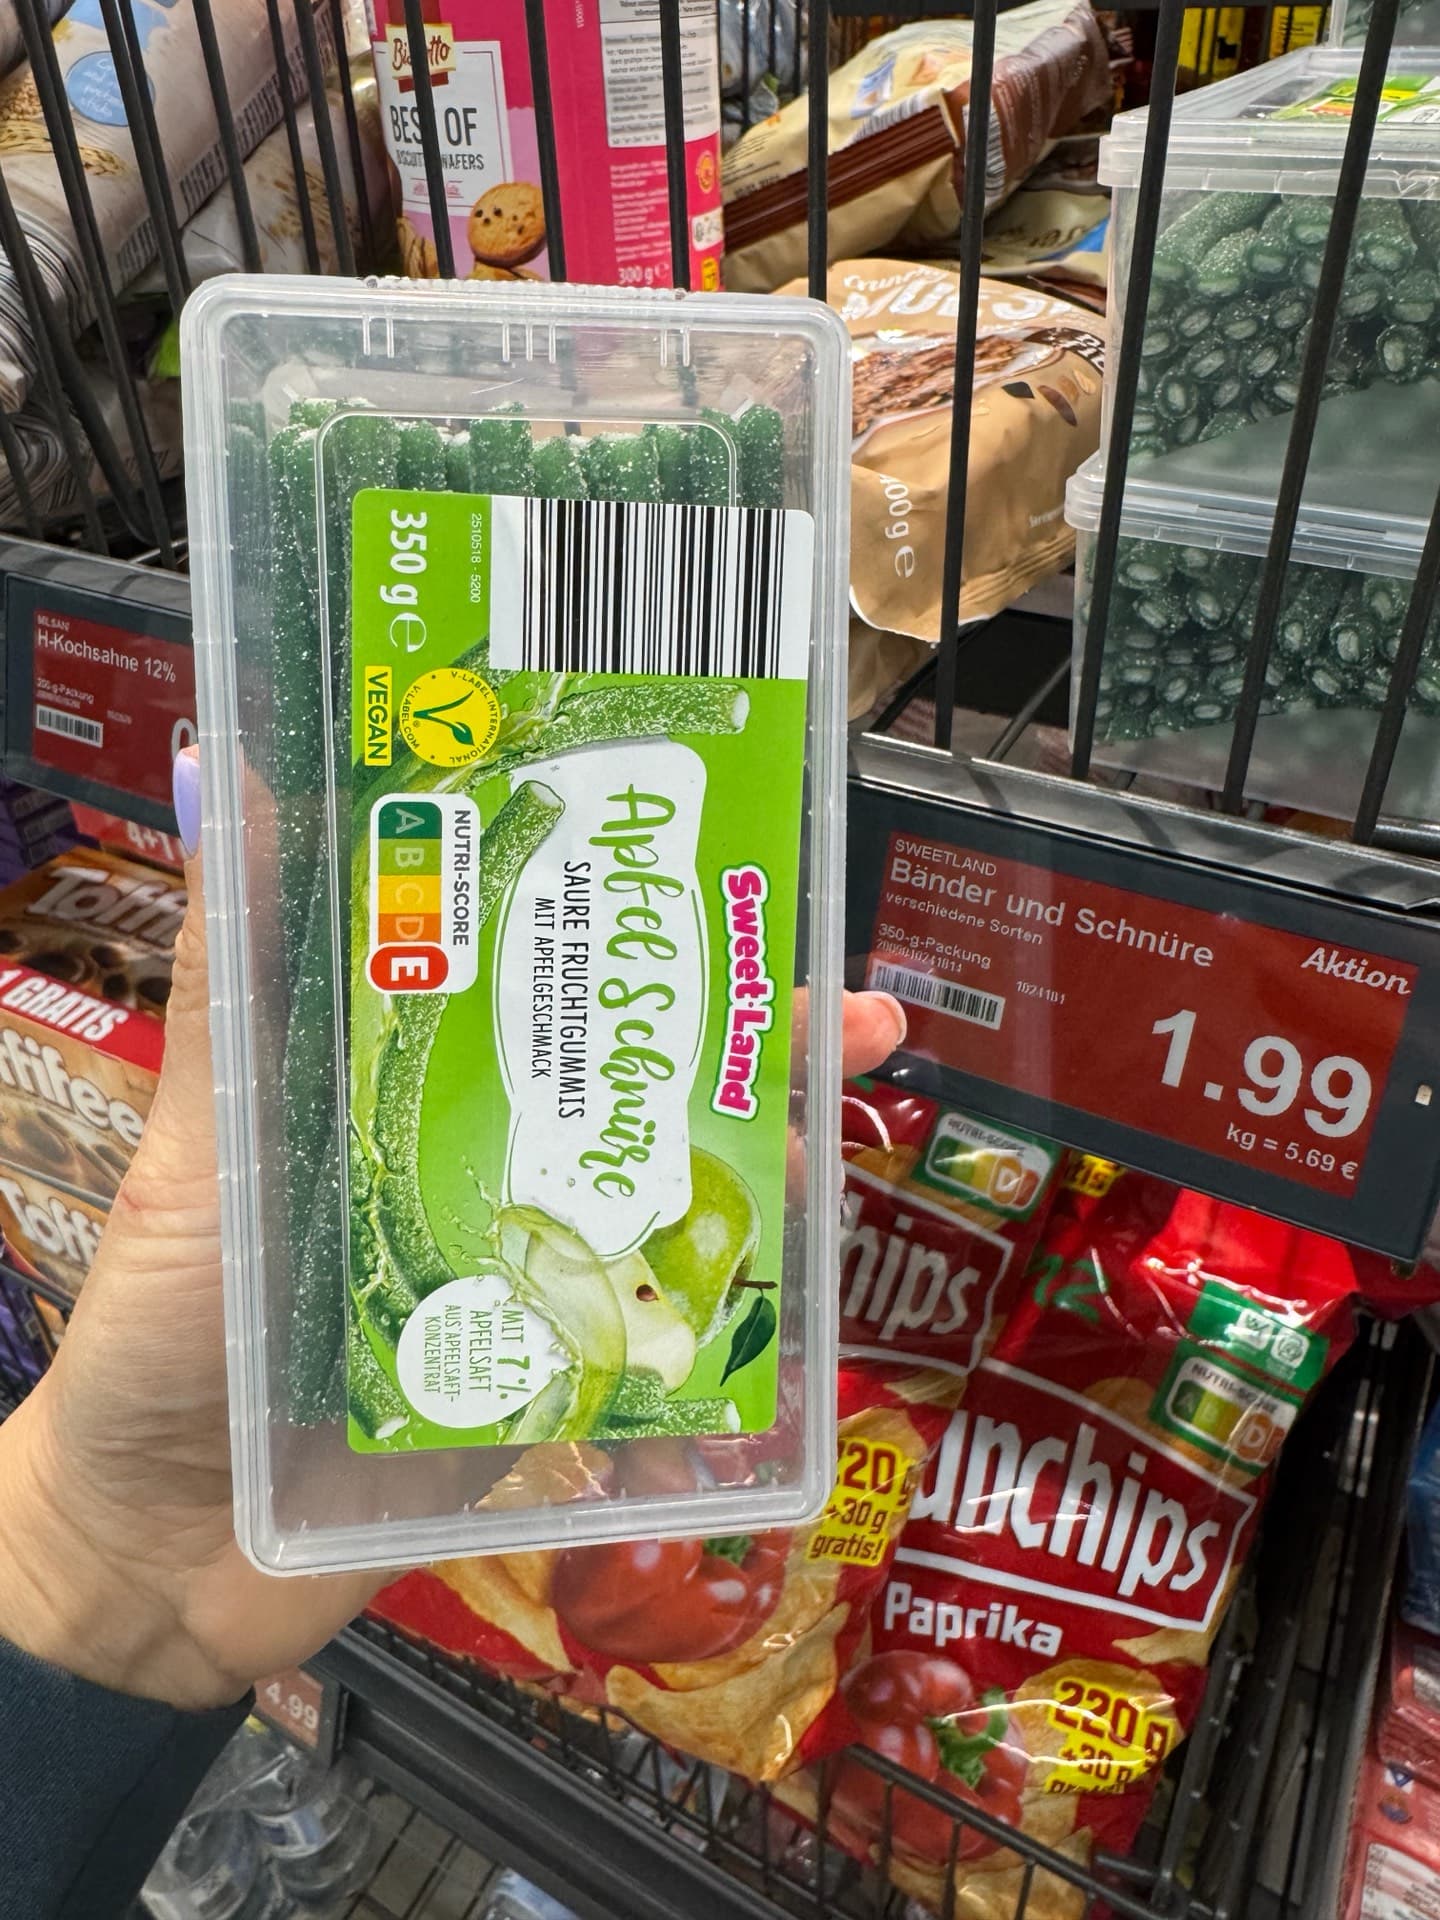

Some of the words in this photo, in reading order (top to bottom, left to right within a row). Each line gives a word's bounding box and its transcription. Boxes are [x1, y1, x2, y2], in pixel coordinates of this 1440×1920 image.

[390, 104, 424, 144] BES
[444, 107, 477, 146] OF
[390, 509, 428, 575] 350
[470, 512, 482, 565] 2510518
[470, 574, 482, 604] 5200
[37, 628, 139, 672] H-Kochsahne
[144, 657, 177, 684] 12%
[367, 671, 388, 760] VEGAN
[449, 700, 498, 764] INTERNATIONAL
[395, 808, 425, 833] A
[394, 846, 425, 868] B
[452, 809, 471, 946] NUTRI-SCORE
[588, 782, 685, 960] Apfel
[895, 838, 998, 877] SWEETLAND
[395, 884, 425, 905] C
[534, 897, 556, 931] MIT
[563, 860, 591, 931] SAURE
[885, 891, 986, 929] verschiedene
[989, 918, 1044, 946] Sorten
[890, 857, 998, 907] Bänder
[1006, 893, 1067, 927] und
[1074, 908, 1215, 968] Schnüre
[394, 915, 425, 942] D
[390, 956, 430, 982] E
[1301, 946, 1412, 996] Aktion
[3, 976, 129, 1041] GRATIS
[531, 935, 554, 1079] APFELGESCHMACK
[558, 941, 590, 1119] FRUCHTGUMMIS
[578, 977, 677, 1199] Schnüre
[1152, 1008, 1373, 1138] 1.99
[1226, 1122, 1257, 1151] kg
[1284, 1142, 1336, 1173] 5.69
[1340, 1160, 1359, 1180] €
[424, 1316, 442, 1394] KONZENTRAT
[468, 1310, 493, 1393] APFELSAFT
[501, 1309, 524, 1344] MIT
[444, 1332, 461, 1402] APFELSAFT-
[808, 1532, 885, 1561] gratis!
[884, 1580, 1064, 1658] Paprika
[265, 1681, 320, 1730] 4.99
[1055, 1680, 1140, 1749] 220
